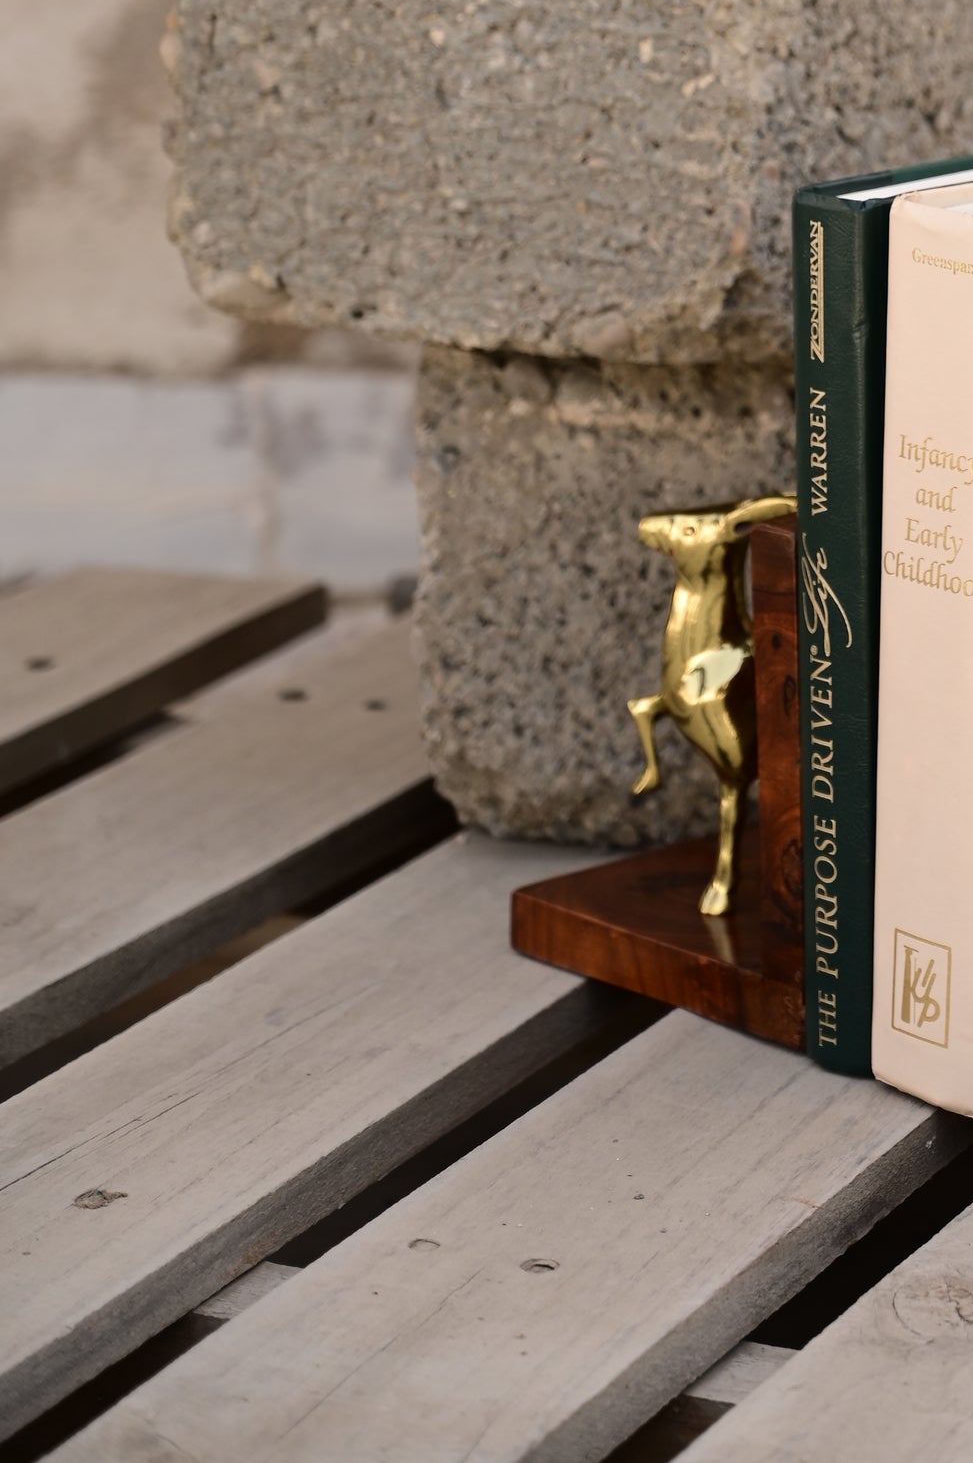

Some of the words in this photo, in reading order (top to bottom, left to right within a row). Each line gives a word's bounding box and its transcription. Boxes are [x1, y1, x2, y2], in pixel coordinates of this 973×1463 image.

[810, 220, 825, 364] ZONDERVAN
[811, 387, 829, 517] WARREN
[915, 486, 957, 514] and
[802, 533, 851, 657] Life
[904, 517, 964, 564] Early
[814, 815, 839, 979] PURPOSE
[819, 990, 837, 1046] THE
